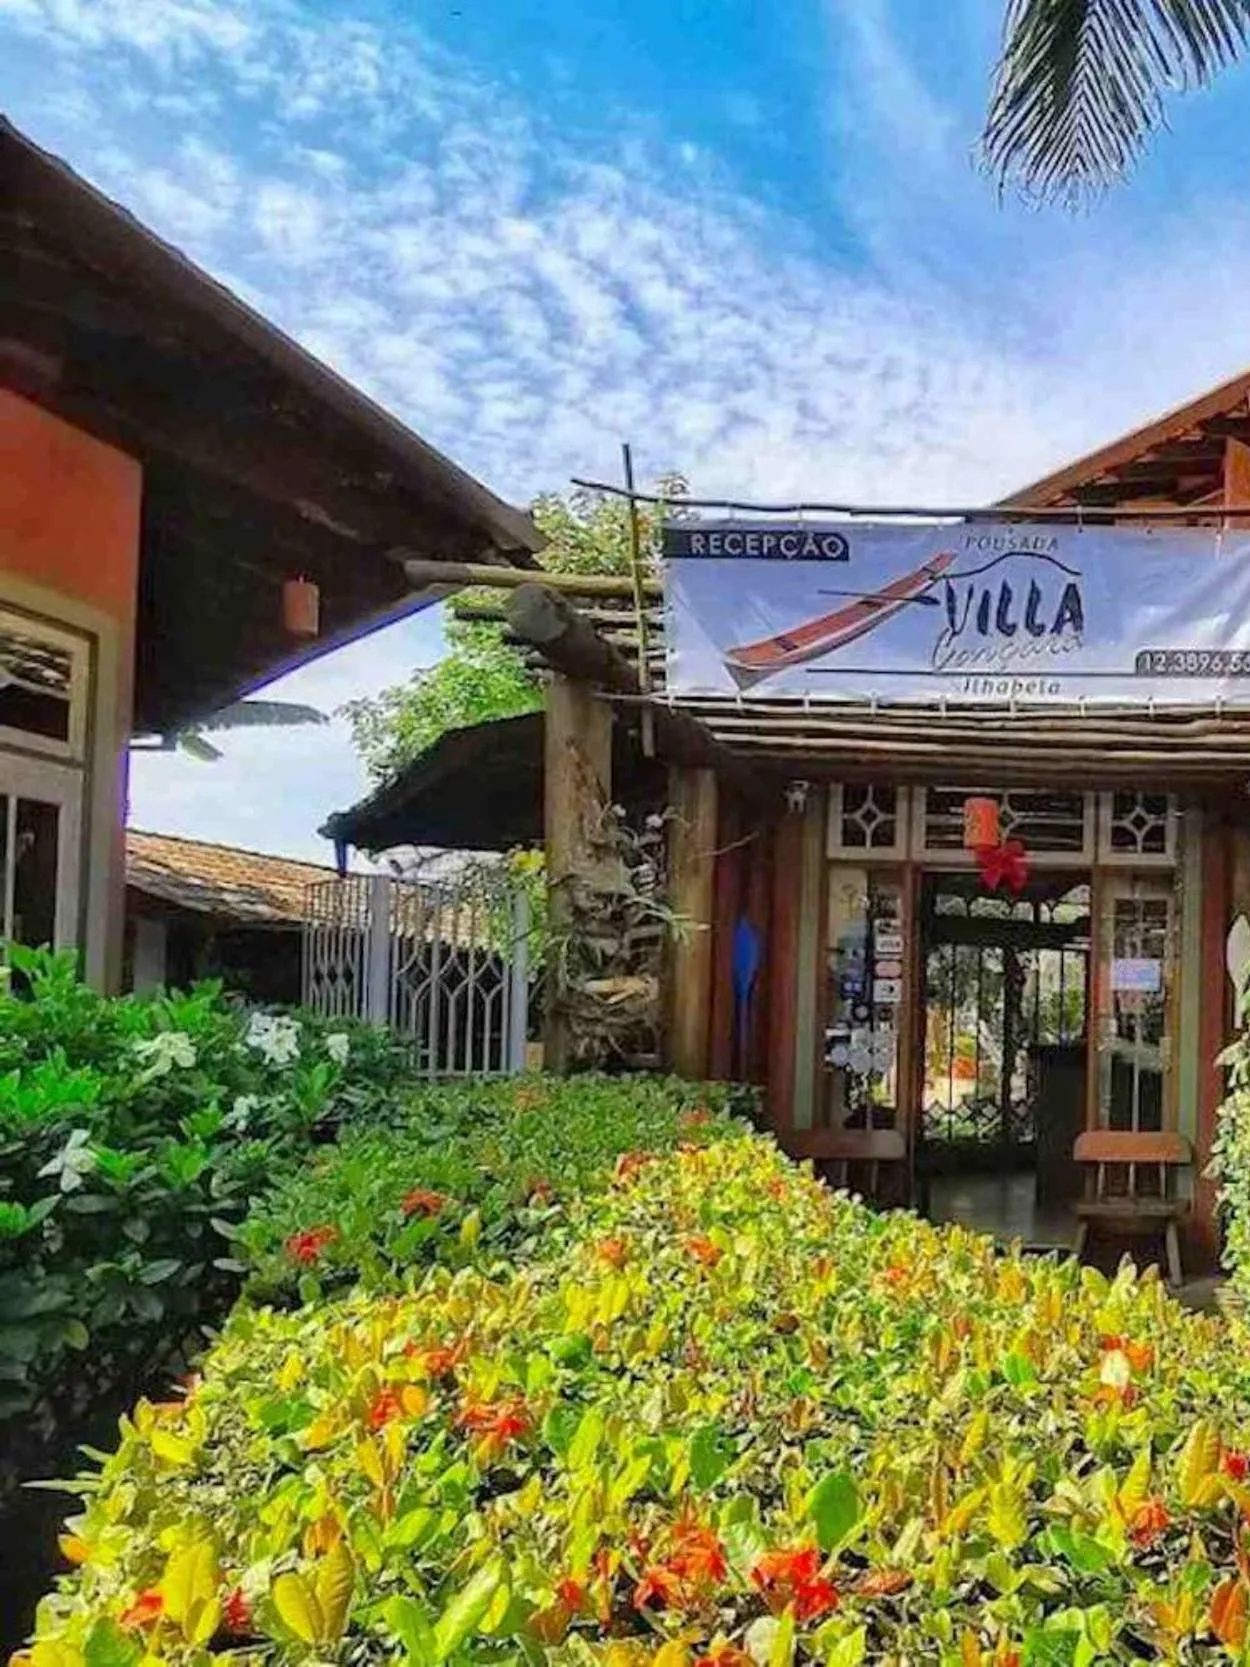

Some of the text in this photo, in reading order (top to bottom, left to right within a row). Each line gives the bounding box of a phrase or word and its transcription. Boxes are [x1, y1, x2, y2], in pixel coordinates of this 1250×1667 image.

[964, 536, 1058, 552] POUSADA
[946, 579, 1084, 636] VILLA
[963, 678, 1060, 697] Ilhabela
